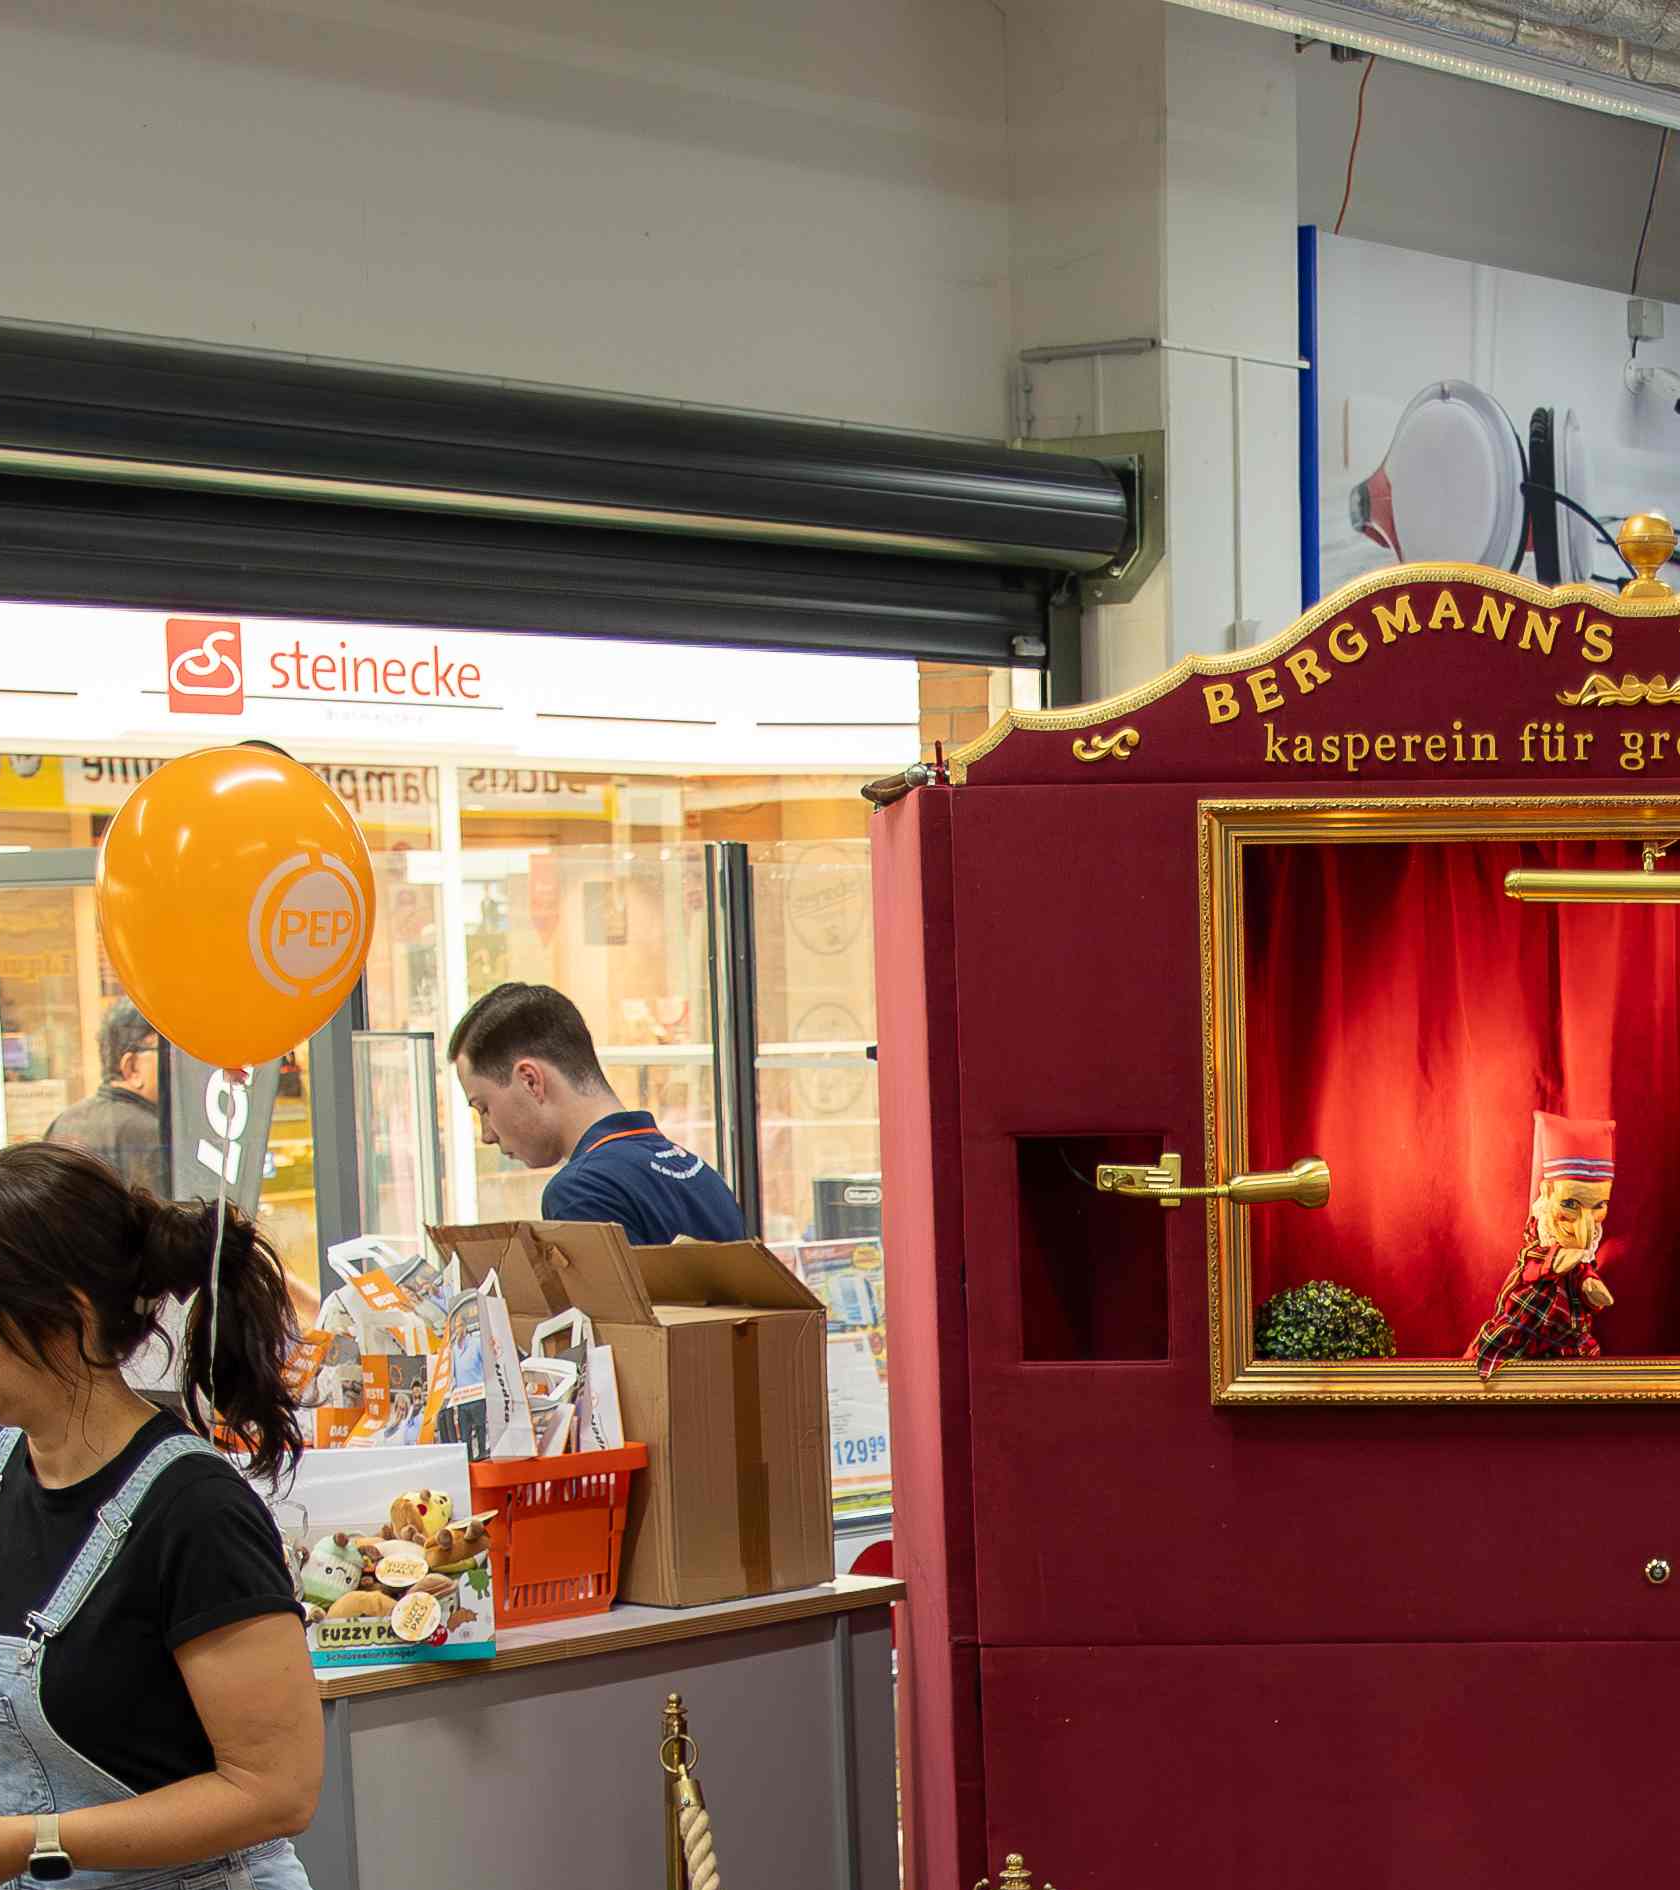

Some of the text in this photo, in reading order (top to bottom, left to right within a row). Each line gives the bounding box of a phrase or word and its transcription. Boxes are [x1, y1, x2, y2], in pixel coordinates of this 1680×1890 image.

[270, 640, 481, 699] steinecke
[1203, 588, 1615, 726] BERGMANN'S
[1264, 721, 1487, 772] kasperein
[1519, 721, 1594, 763] für
[279, 909, 353, 947] PEP
[322, 1626, 399, 1641] FUZZY PA
